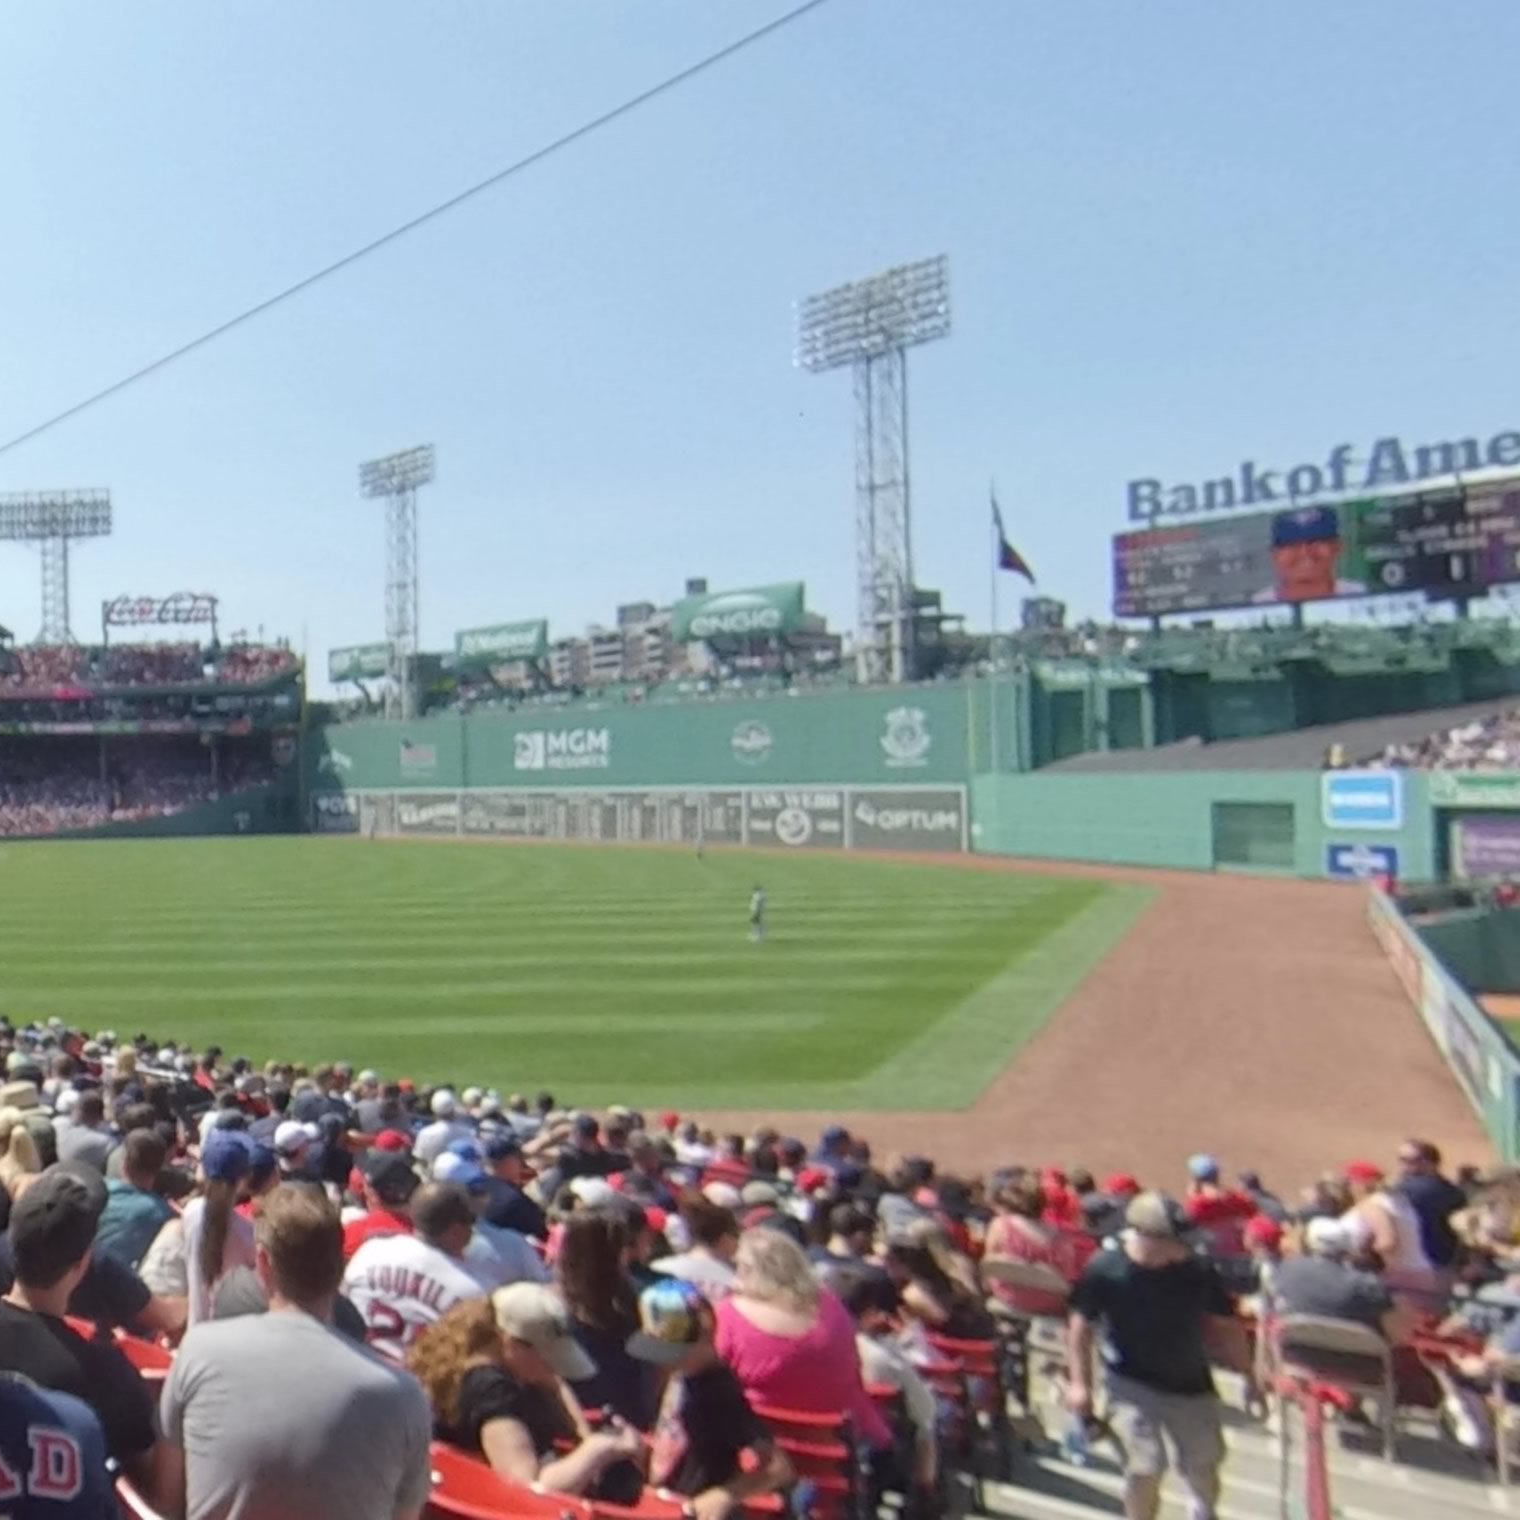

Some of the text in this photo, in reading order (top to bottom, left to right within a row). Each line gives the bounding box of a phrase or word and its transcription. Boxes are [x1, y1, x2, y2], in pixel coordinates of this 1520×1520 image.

[1127, 461, 1279, 521] Bank
[1287, 444, 1353, 496] of
[547, 728, 609, 754] MGM
[878, 811, 958, 831] OPTUM
